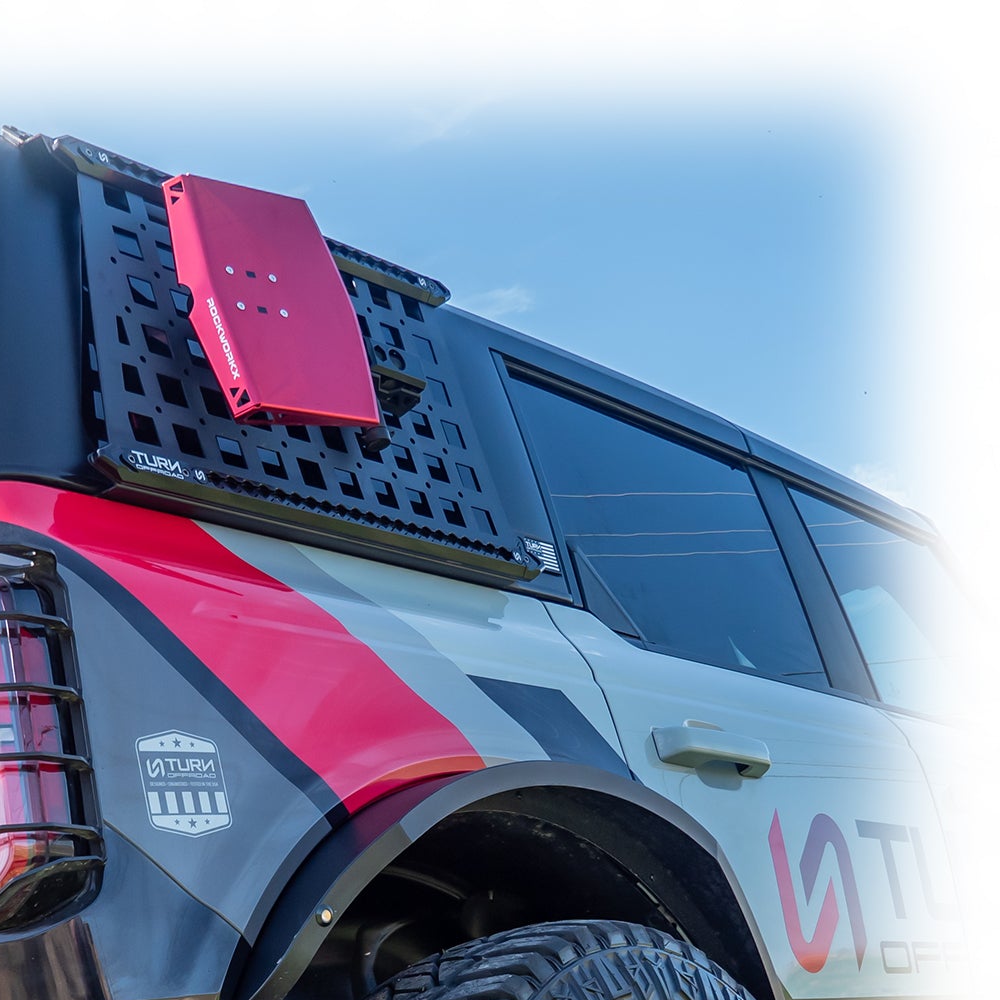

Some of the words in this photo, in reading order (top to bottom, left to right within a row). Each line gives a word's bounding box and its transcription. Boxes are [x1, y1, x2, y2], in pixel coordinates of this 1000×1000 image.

[206, 297, 241, 381] ROCKWORKX
[131, 450, 182, 474] TURN
[135, 463, 185, 480] OFFROAD
[164, 758, 216, 773] TURN
